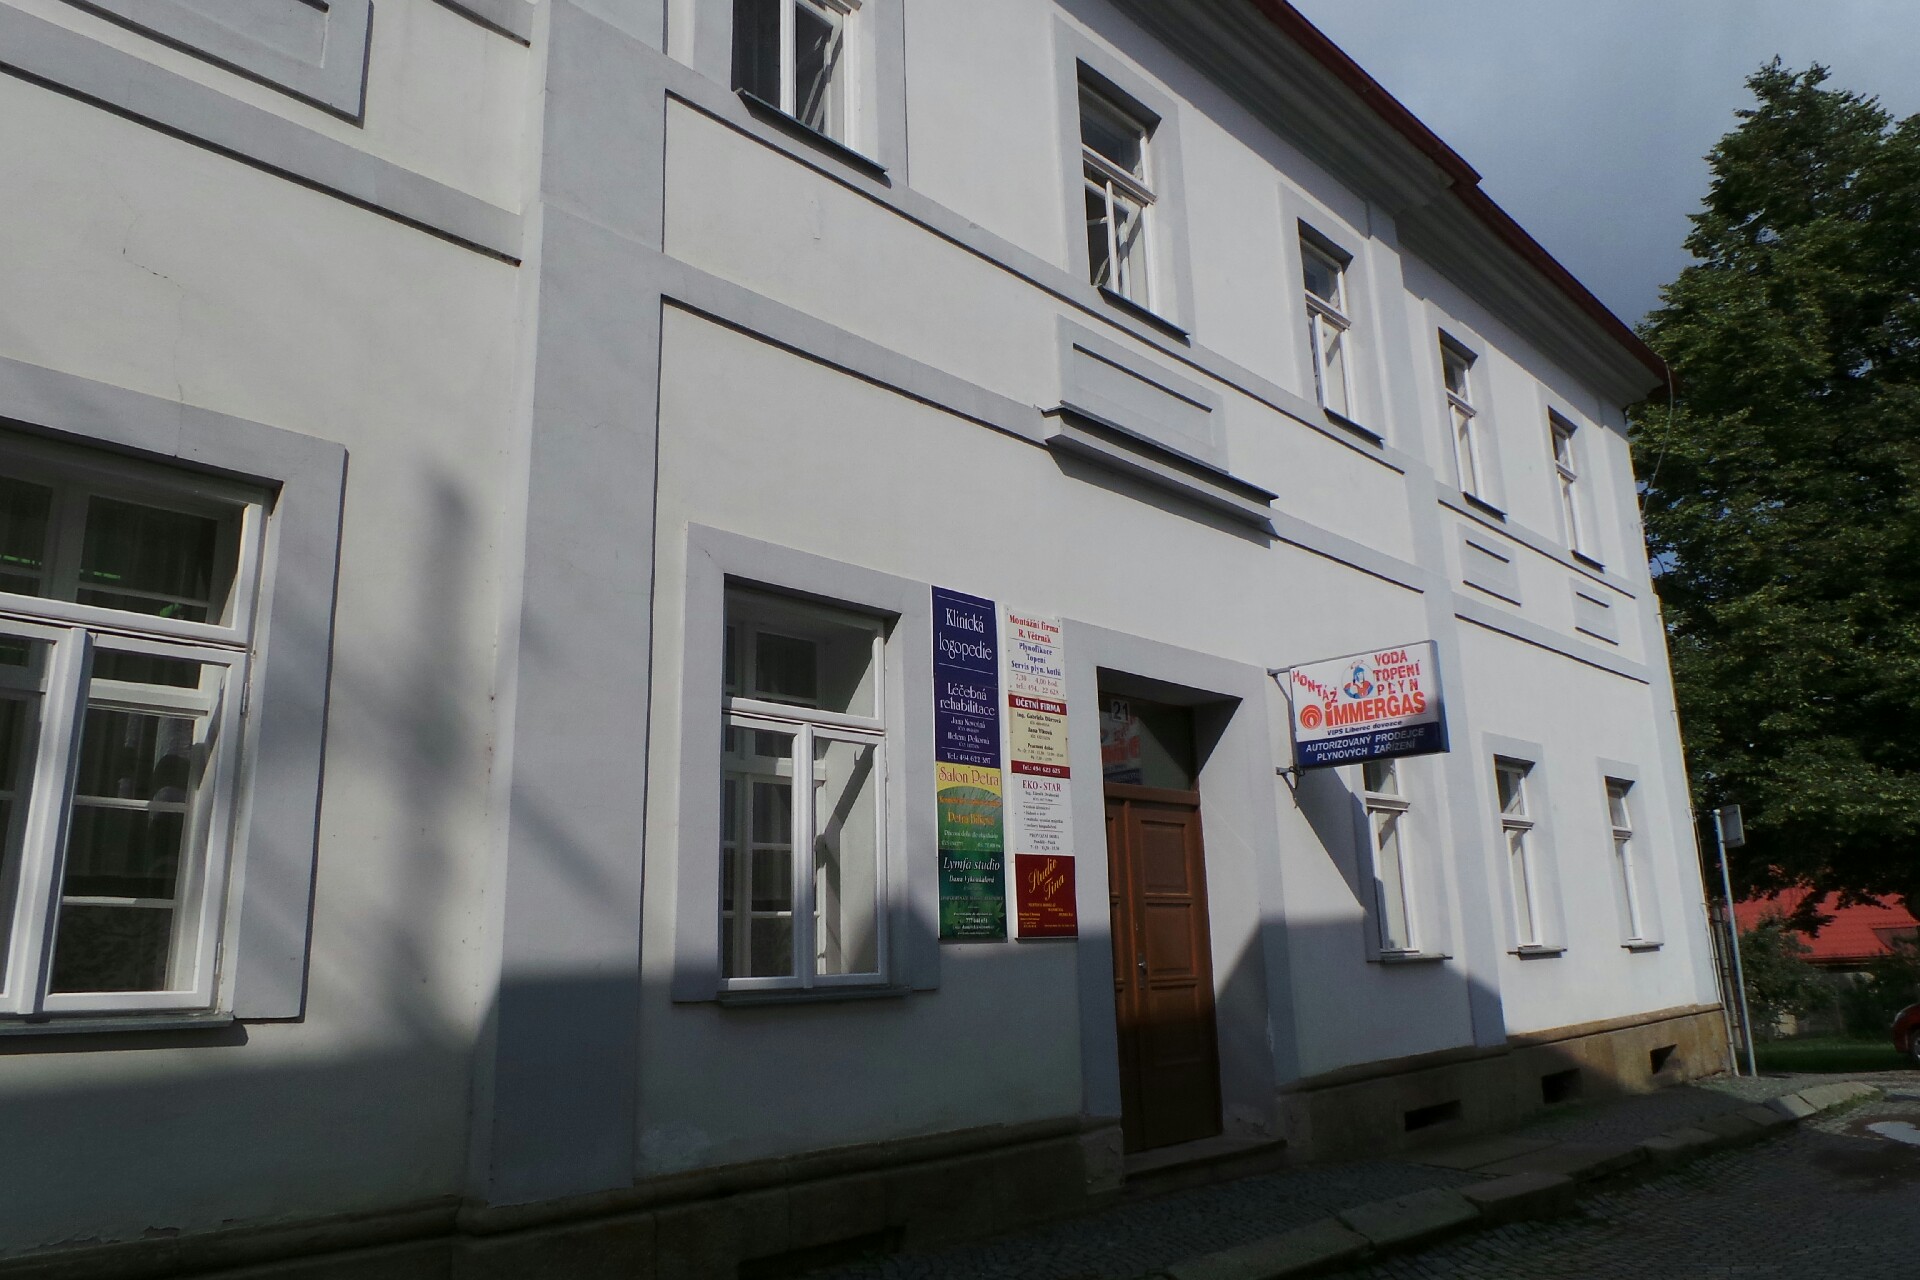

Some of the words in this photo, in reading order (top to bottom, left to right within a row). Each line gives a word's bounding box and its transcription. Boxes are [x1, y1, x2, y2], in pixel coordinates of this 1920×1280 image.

[946, 608, 984, 633] Klinická
[1010, 614, 1040, 629] Montážní
[1041, 621, 1059, 634] firma
[1018, 628, 1026, 638] R.
[939, 632, 992, 661] logopedie
[1019, 642, 1052, 656] Plynofikace
[1011, 660, 1030, 670] Servis
[1030, 664, 1046, 674] plyn.
[1026, 654, 1046, 664] Topení
[1374, 650, 1408, 666] VODA
[1373, 659, 1421, 682] TOPENÍ
[948, 682, 987, 700] Léčebná
[940, 696, 995, 716] rehabilitace
[1016, 698, 1039, 710] ÚČETNÍ
[1040, 702, 1060, 712] FIRMA
[1112, 701, 1128, 720] 21
[1327, 728, 1343, 736] VIPS
[1344, 725, 1371, 734] Liberec
[1372, 720, 1402, 730] dovozce
[1306, 735, 1372, 752] AUTORIZOVANÝ
[1375, 728, 1424, 742] PRODEJCE
[1316, 746, 1368, 762] PLYNOVÝCH
[1374, 738, 1416, 754] ZAŘÍZENÍ
[938, 766, 968, 783] Salon
[971, 770, 998, 786] Petra
[1022, 780, 1038, 790] EKO
[1044, 782, 1062, 792] STAR
[944, 857, 972, 872] Lymfa
[974, 858, 1000, 871] studio
[1028, 858, 1057, 894] Studio
